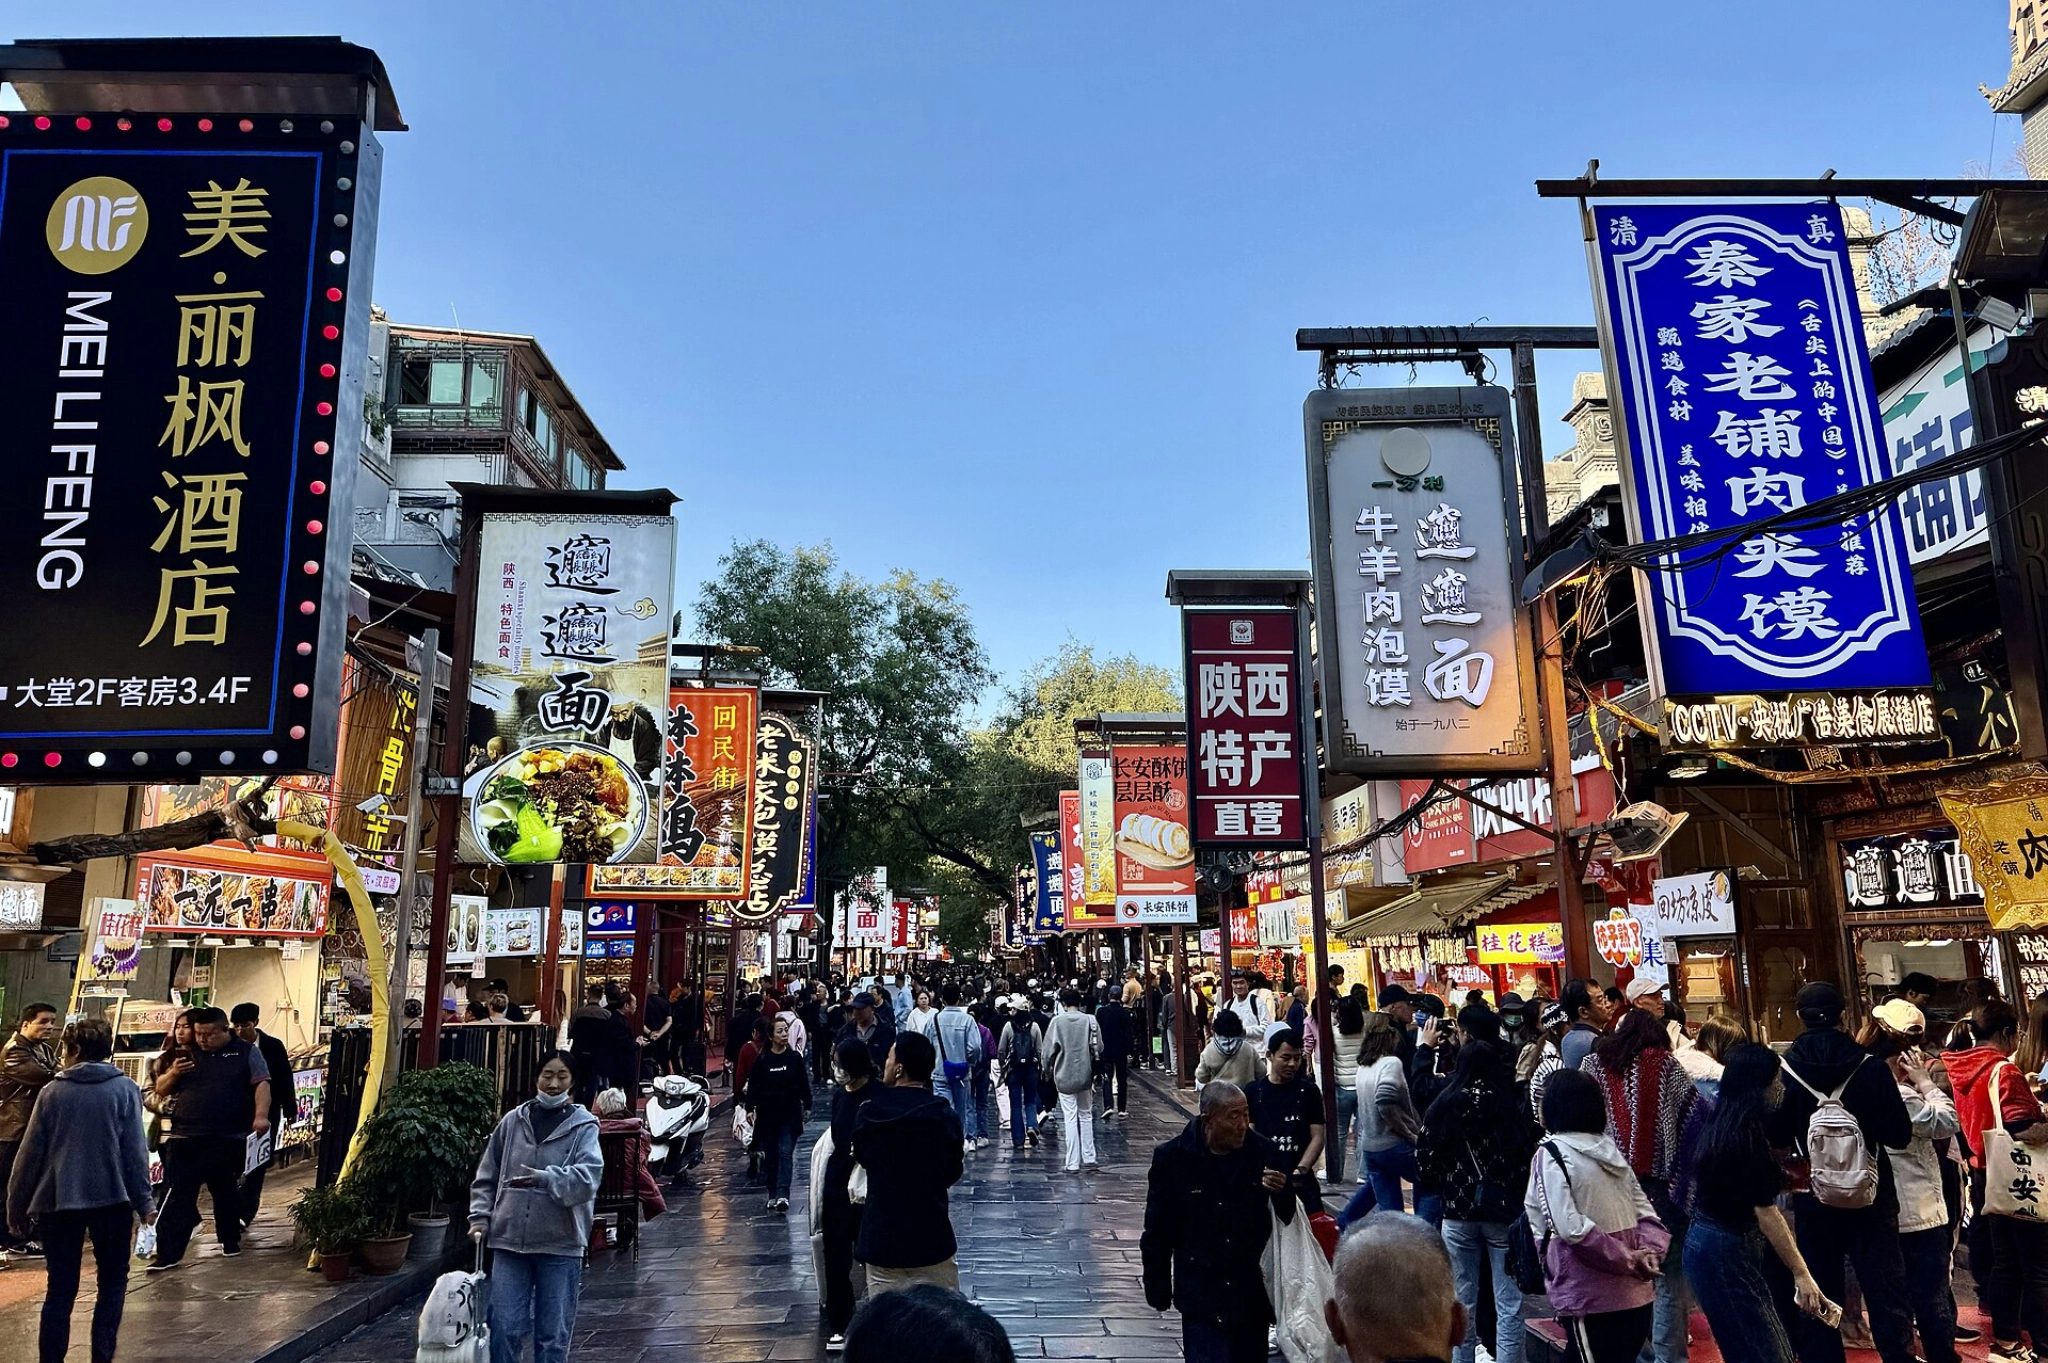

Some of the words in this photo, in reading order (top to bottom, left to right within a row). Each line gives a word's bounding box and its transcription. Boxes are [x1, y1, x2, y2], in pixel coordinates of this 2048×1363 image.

[1610, 216, 1638, 246] 清
[1806, 214, 1835, 243] 真
[58, 291, 112, 378] MEI
[1657, 327, 1693, 421] 甄选食材
[1684, 240, 1841, 640] 秦家老铺肉夹馍
[1371, 475, 1444, 492] 一分利
[36, 444, 97, 590] FENG
[1354, 505, 1413, 708] 牛羊肉泡馍
[14, 676, 252, 708] 大堂2F客房3.4F
[1199, 662, 1289, 718] 陕西
[1395, 718, 1471, 731] 始于一九八二
[707, 705, 739, 791] 回民街
[1113, 756, 1188, 779] 长安酥饼
[1200, 729, 1292, 787] 特产
[1114, 781, 1173, 803] 层层酥
[1214, 801, 1284, 836] 直营
[173, 873, 280, 931] 一元一串
[1143, 900, 1188, 913] 长安酥饼
[1656, 883, 1719, 925] 回坊凉皮
[1481, 931, 1553, 954] 桂花糕
[1595, 922, 1640, 949] 柿子熟了
[2008, 1147, 2041, 1203] 西安
